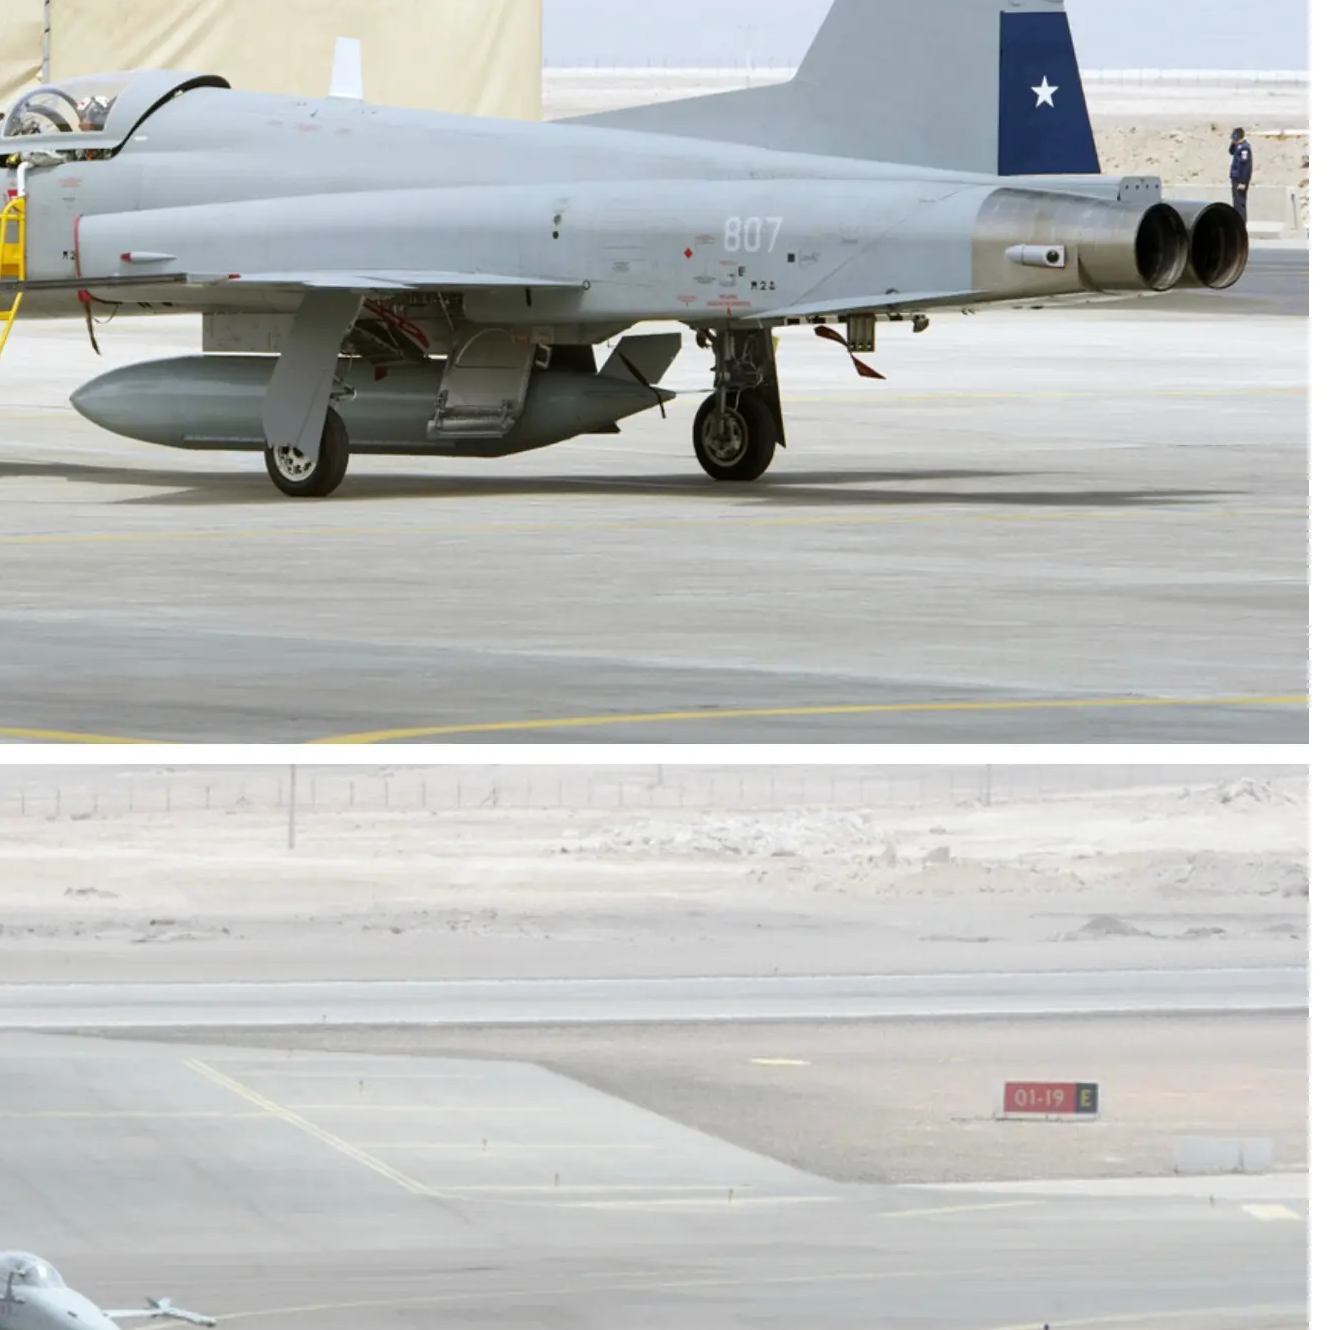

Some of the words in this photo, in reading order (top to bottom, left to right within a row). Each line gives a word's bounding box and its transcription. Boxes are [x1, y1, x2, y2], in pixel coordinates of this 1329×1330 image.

[723, 215, 783, 254] 807
[1014, 1088, 1065, 1108] 01-19
[1080, 1089, 1092, 1108] E
